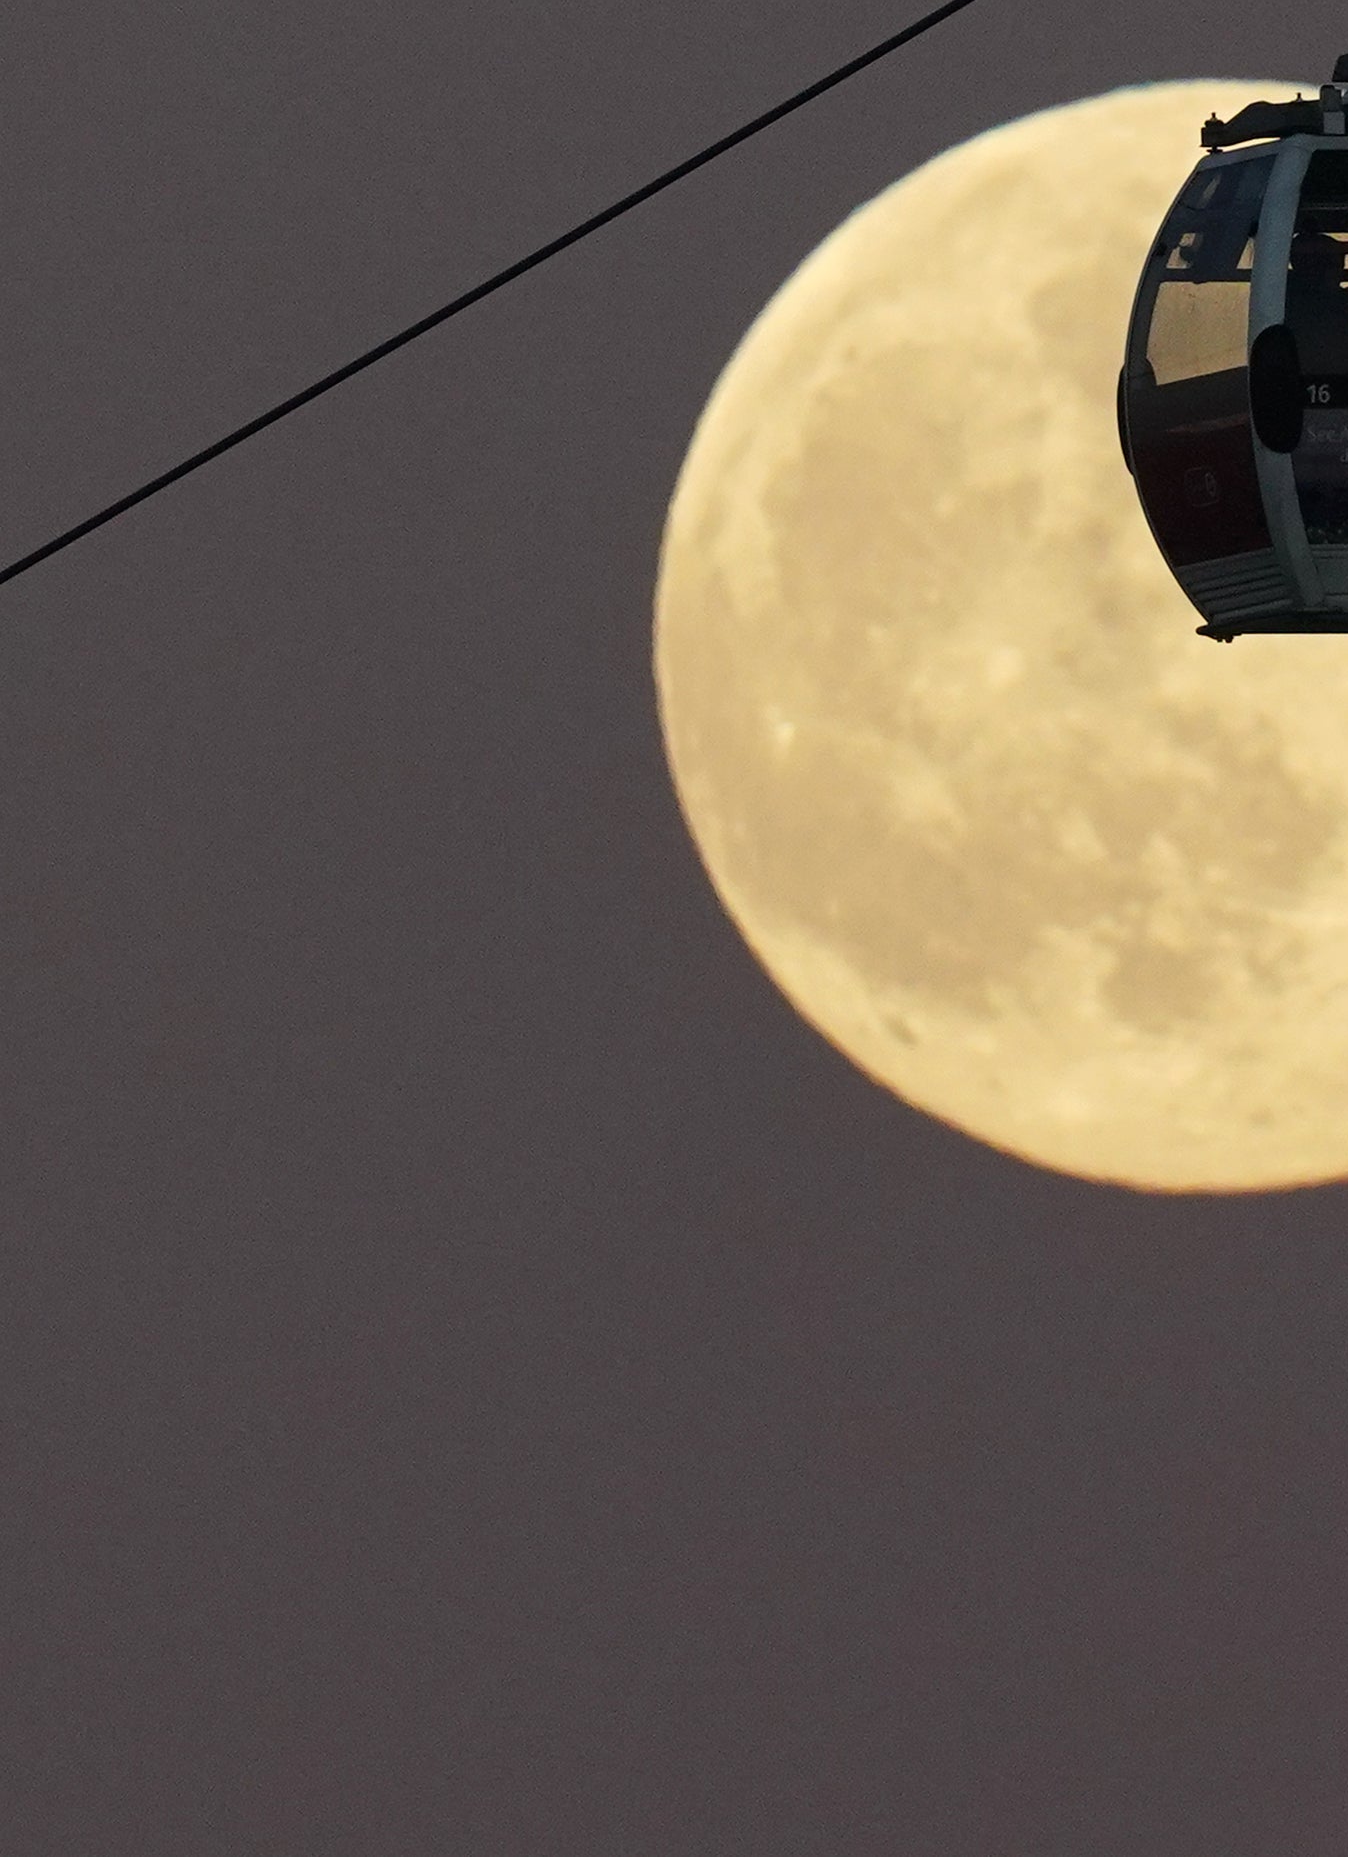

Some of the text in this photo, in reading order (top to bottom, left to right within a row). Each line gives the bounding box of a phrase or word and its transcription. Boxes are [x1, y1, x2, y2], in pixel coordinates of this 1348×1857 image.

[1306, 383, 1331, 403] 16
[1306, 427, 1336, 443] See
[1340, 448, 1348, 462] a
